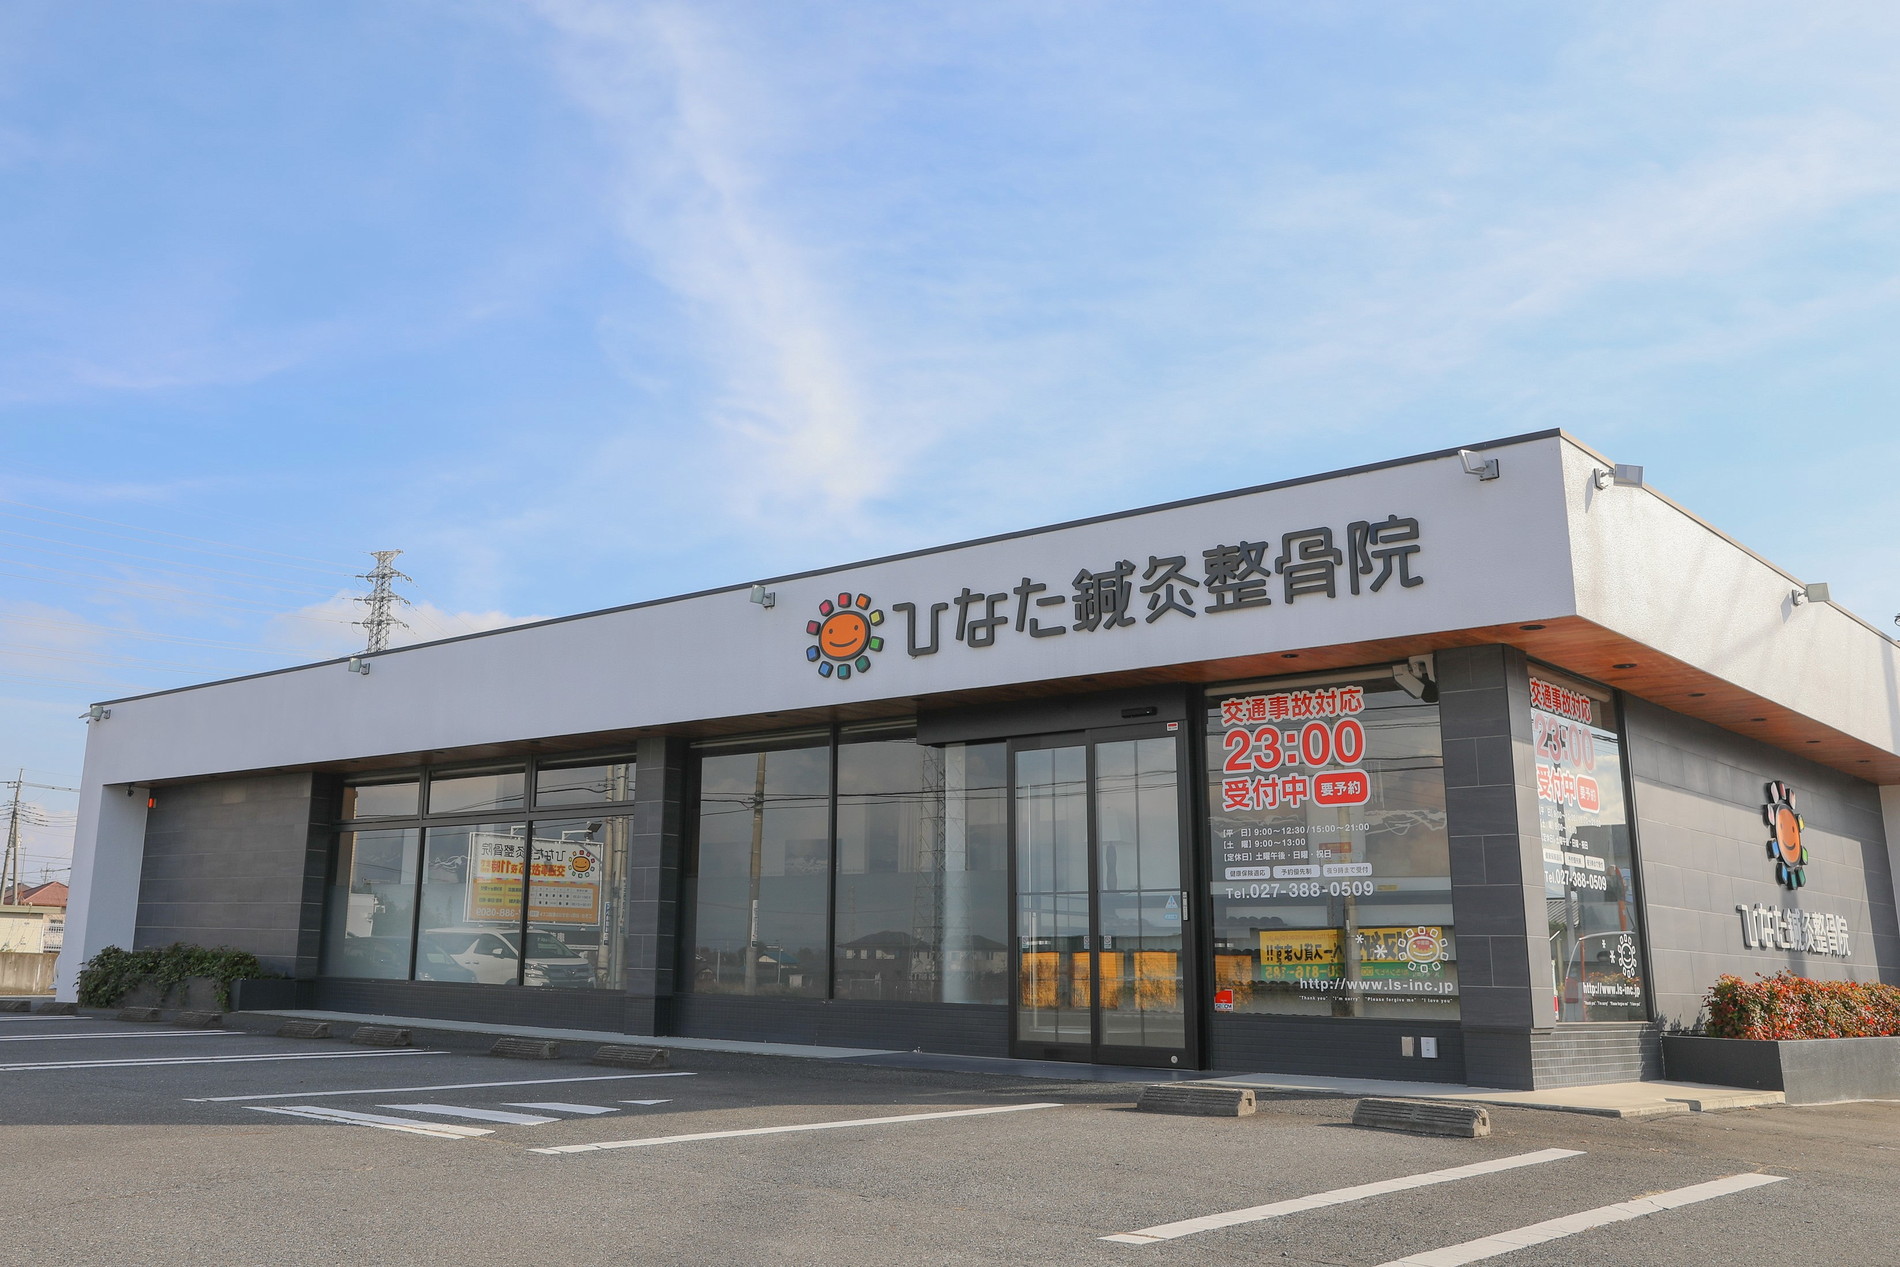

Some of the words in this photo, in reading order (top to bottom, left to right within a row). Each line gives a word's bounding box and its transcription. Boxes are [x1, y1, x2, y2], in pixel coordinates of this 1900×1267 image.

[892, 513, 1425, 657] ひなた鍼灸整骨院
[1222, 686, 1366, 726] 交通事故対応
[1529, 677, 1593, 724] 交通事故対応
[1223, 718, 1367, 773] 23:00
[1534, 713, 1596, 774] 23:00
[1222, 774, 1310, 811] 受付中
[1320, 781, 1361, 798] 要予約
[1536, 765, 1577, 807] 受付中
[1736, 902, 1852, 957] ひなた鍼灸整骨院
[1299, 977, 1454, 994] http://www.ls-inc.jp
